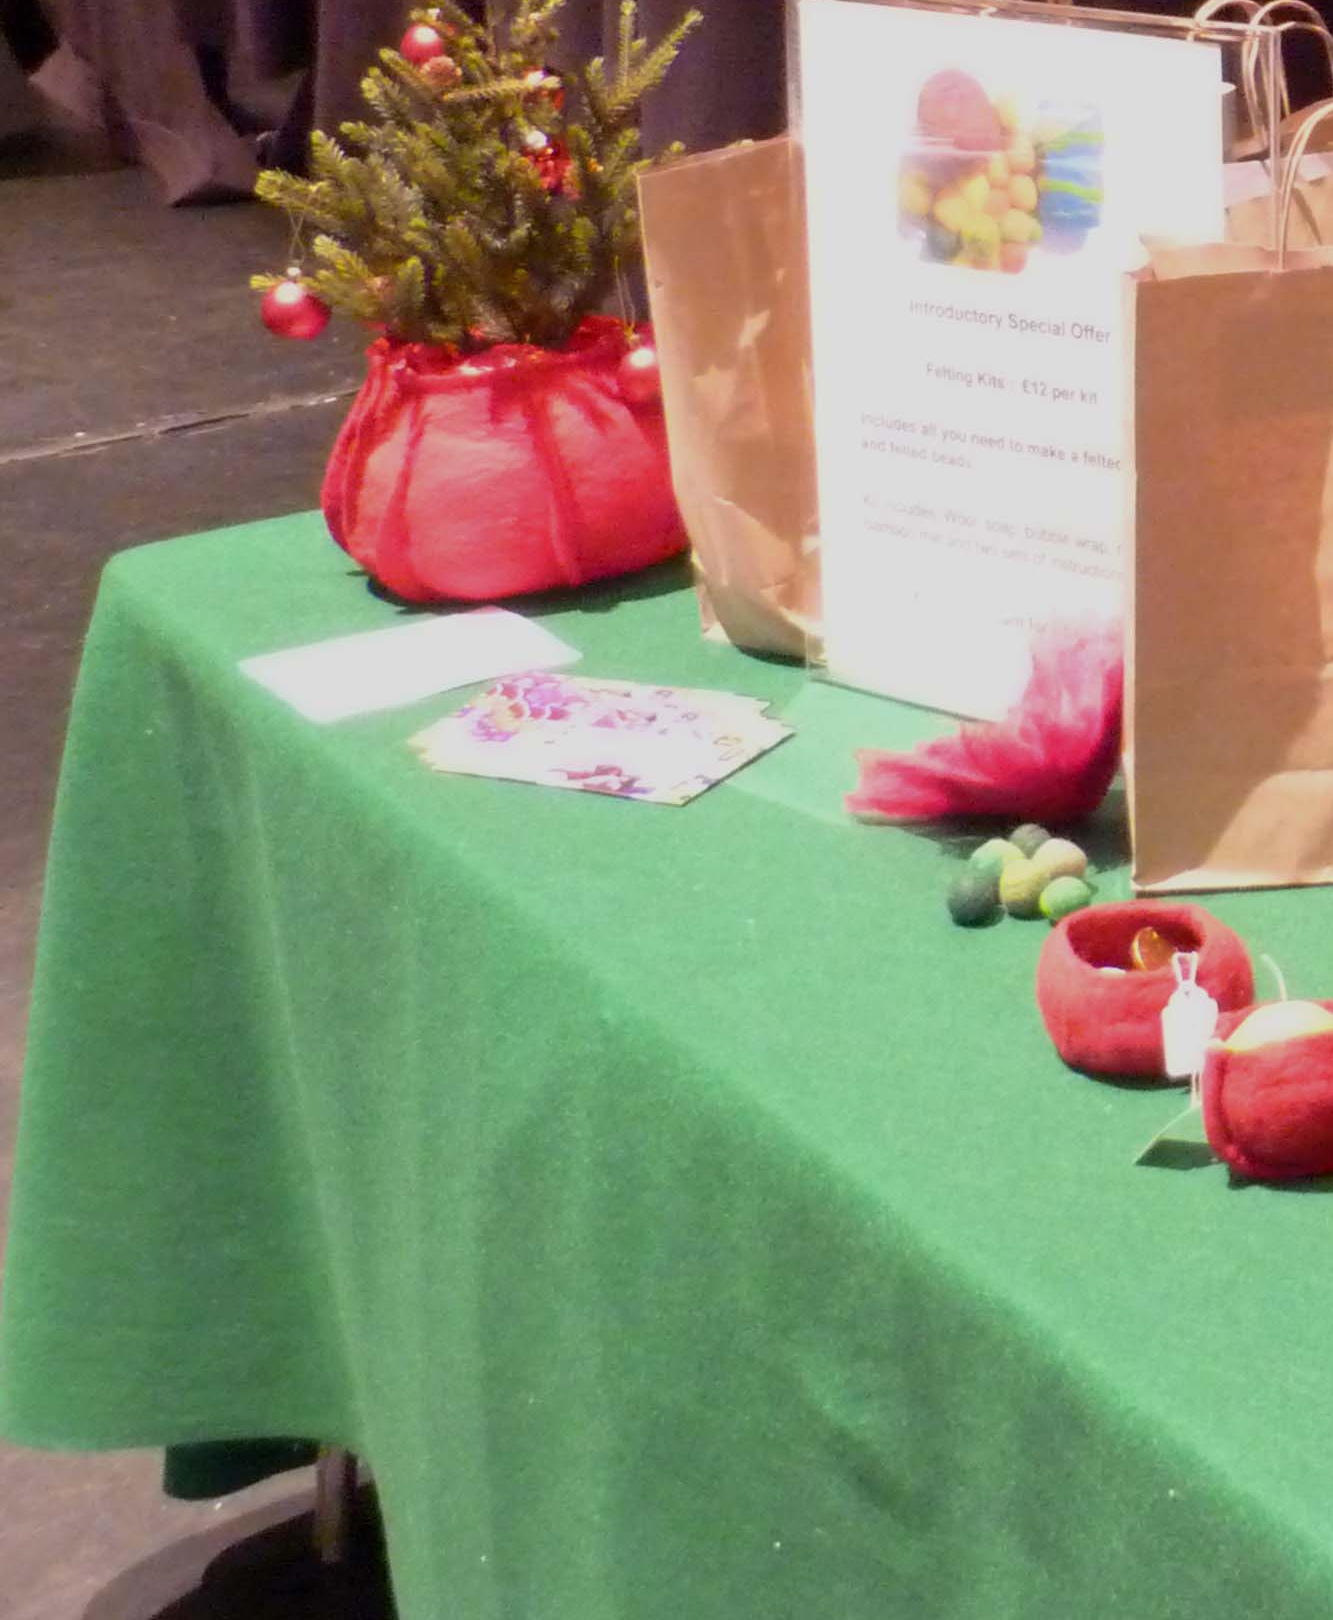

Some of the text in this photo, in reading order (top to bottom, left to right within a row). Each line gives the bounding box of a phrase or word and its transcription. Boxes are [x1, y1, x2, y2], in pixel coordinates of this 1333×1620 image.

[910, 300, 1110, 343] Introductory Special Offer
[926, 361, 973, 387] Felting
[978, 372, 1004, 390] Kits
[1052, 386, 1074, 402] per
[1080, 388, 1098, 405] kit
[921, 420, 938, 437] all
[941, 427, 967, 443] you
[971, 432, 1005, 450] need
[1010, 439, 1023, 453] to
[1027, 443, 1066, 461] make
[1071, 453, 1079, 462] a
